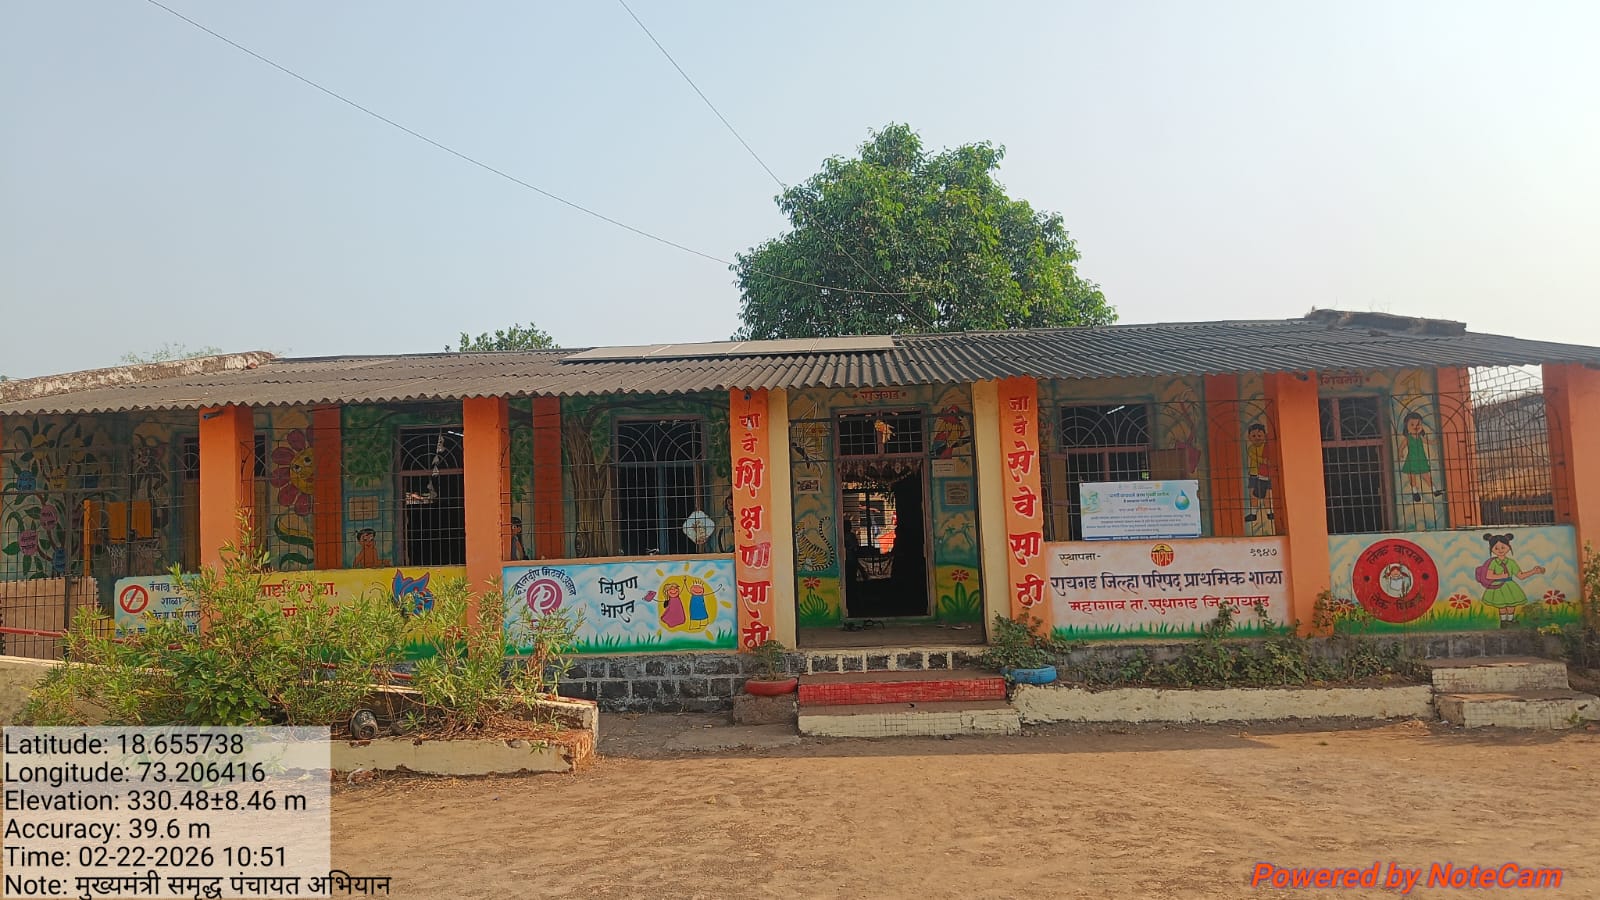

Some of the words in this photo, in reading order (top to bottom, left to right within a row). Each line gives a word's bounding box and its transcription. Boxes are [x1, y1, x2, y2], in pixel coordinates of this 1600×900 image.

[598, 576, 639, 599] निपुण
[1050, 576, 1097, 596] रायगड
[1101, 572, 1140, 594] जिल्हा
[1184, 569, 1245, 587] प्राथमिक
[1249, 570, 1282, 589] शाळा
[600, 600, 635, 623] भारत
[1148, 598, 1198, 615] सुधागड
